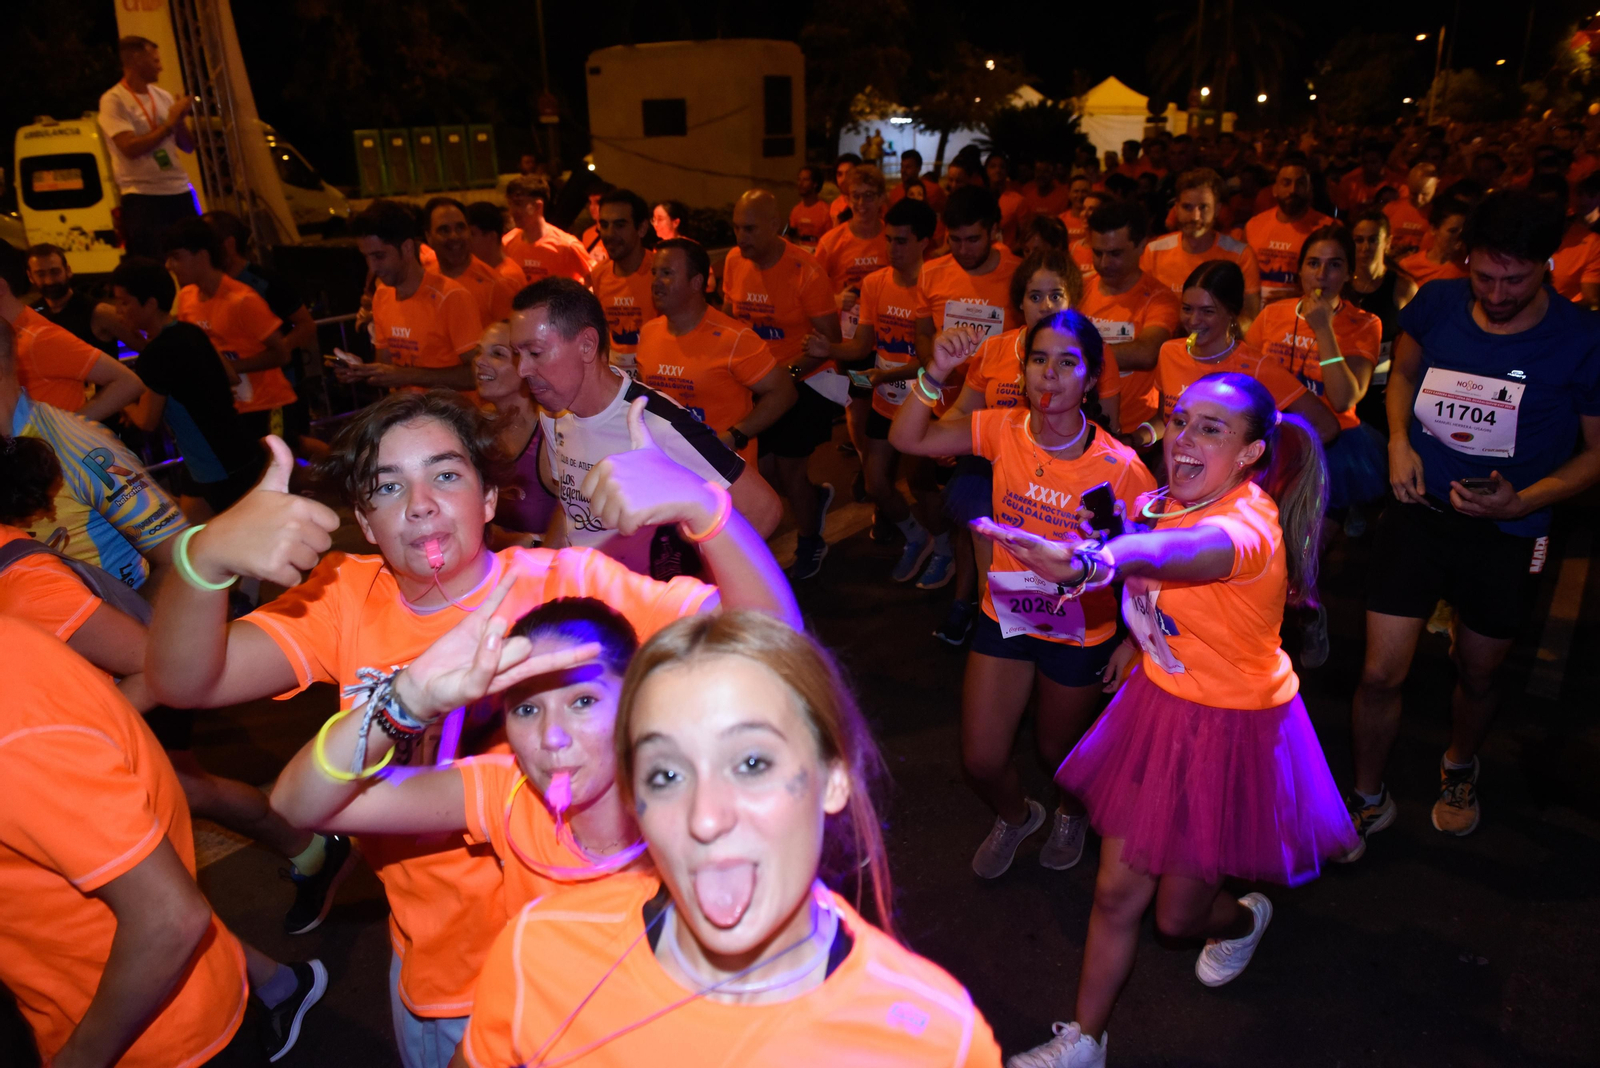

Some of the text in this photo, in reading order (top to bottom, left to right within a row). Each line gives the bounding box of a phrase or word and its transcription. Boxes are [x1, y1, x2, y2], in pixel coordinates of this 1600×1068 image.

[1268, 240, 1292, 251] XXXV
[854, 256, 878, 266] XXXV
[613, 296, 635, 306] XXXV
[746, 292, 768, 303] XXXV
[886, 305, 911, 318] XXXV
[391, 326, 411, 338] XXXV
[657, 364, 684, 377] XXXV
[1435, 400, 1497, 426] 11704
[570, 458, 577, 468] DE
[1025, 481, 1073, 509] XXXV
[1006, 489, 1079, 521] CARRERA NOCTURN
